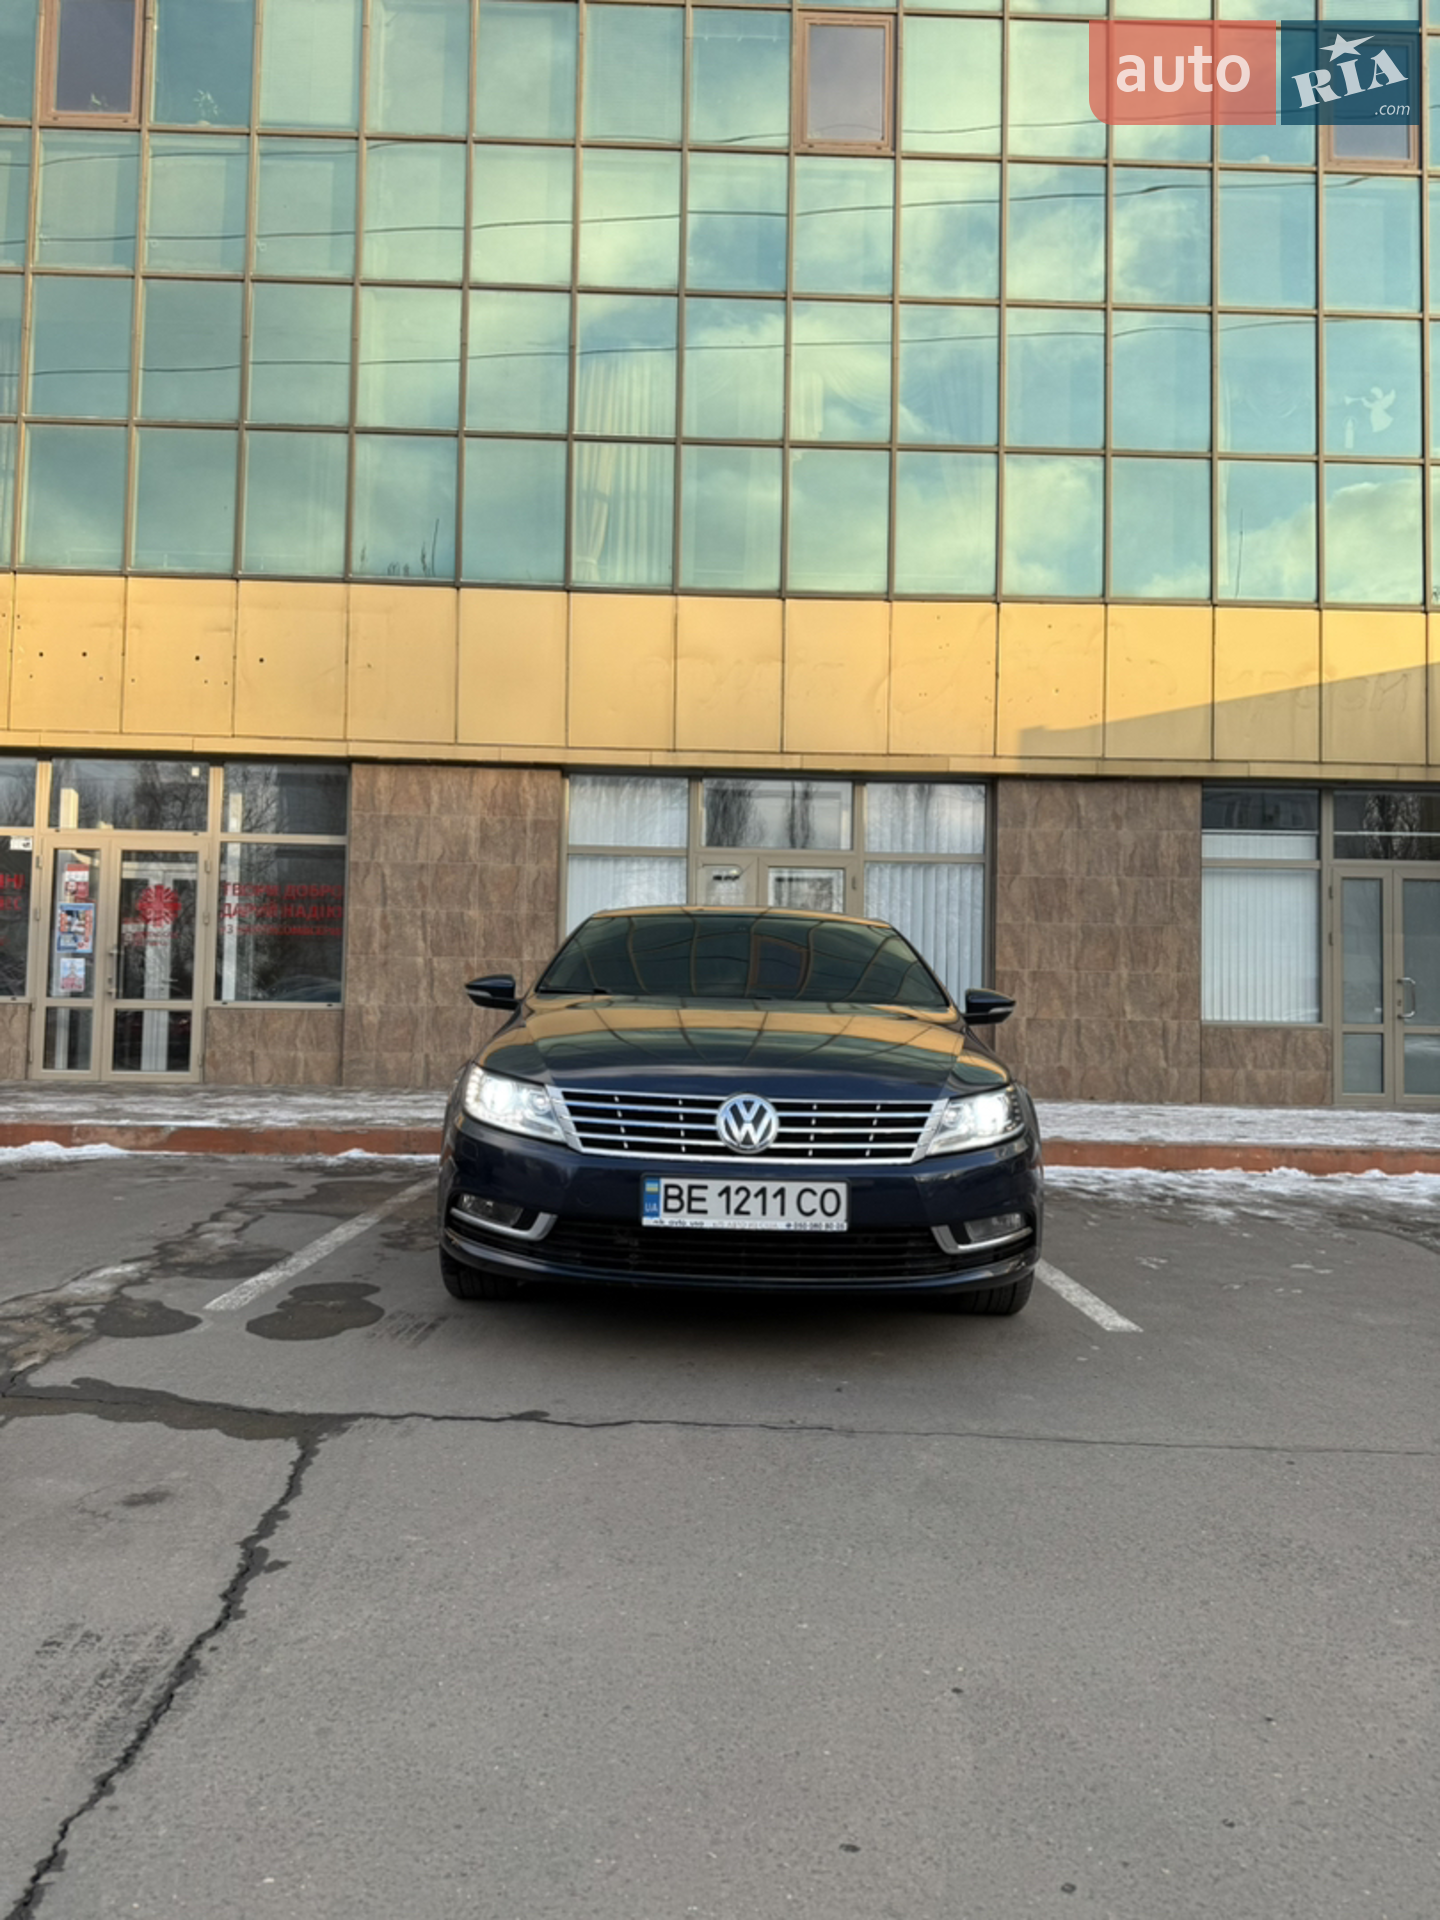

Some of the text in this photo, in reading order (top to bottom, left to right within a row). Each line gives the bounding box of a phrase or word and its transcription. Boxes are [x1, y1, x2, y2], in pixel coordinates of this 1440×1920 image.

[284, 885, 343, 899] ДОБРО
[644, 1202, 659, 1213] UA
[663, 1183, 842, 1218] BE 1211 CO
